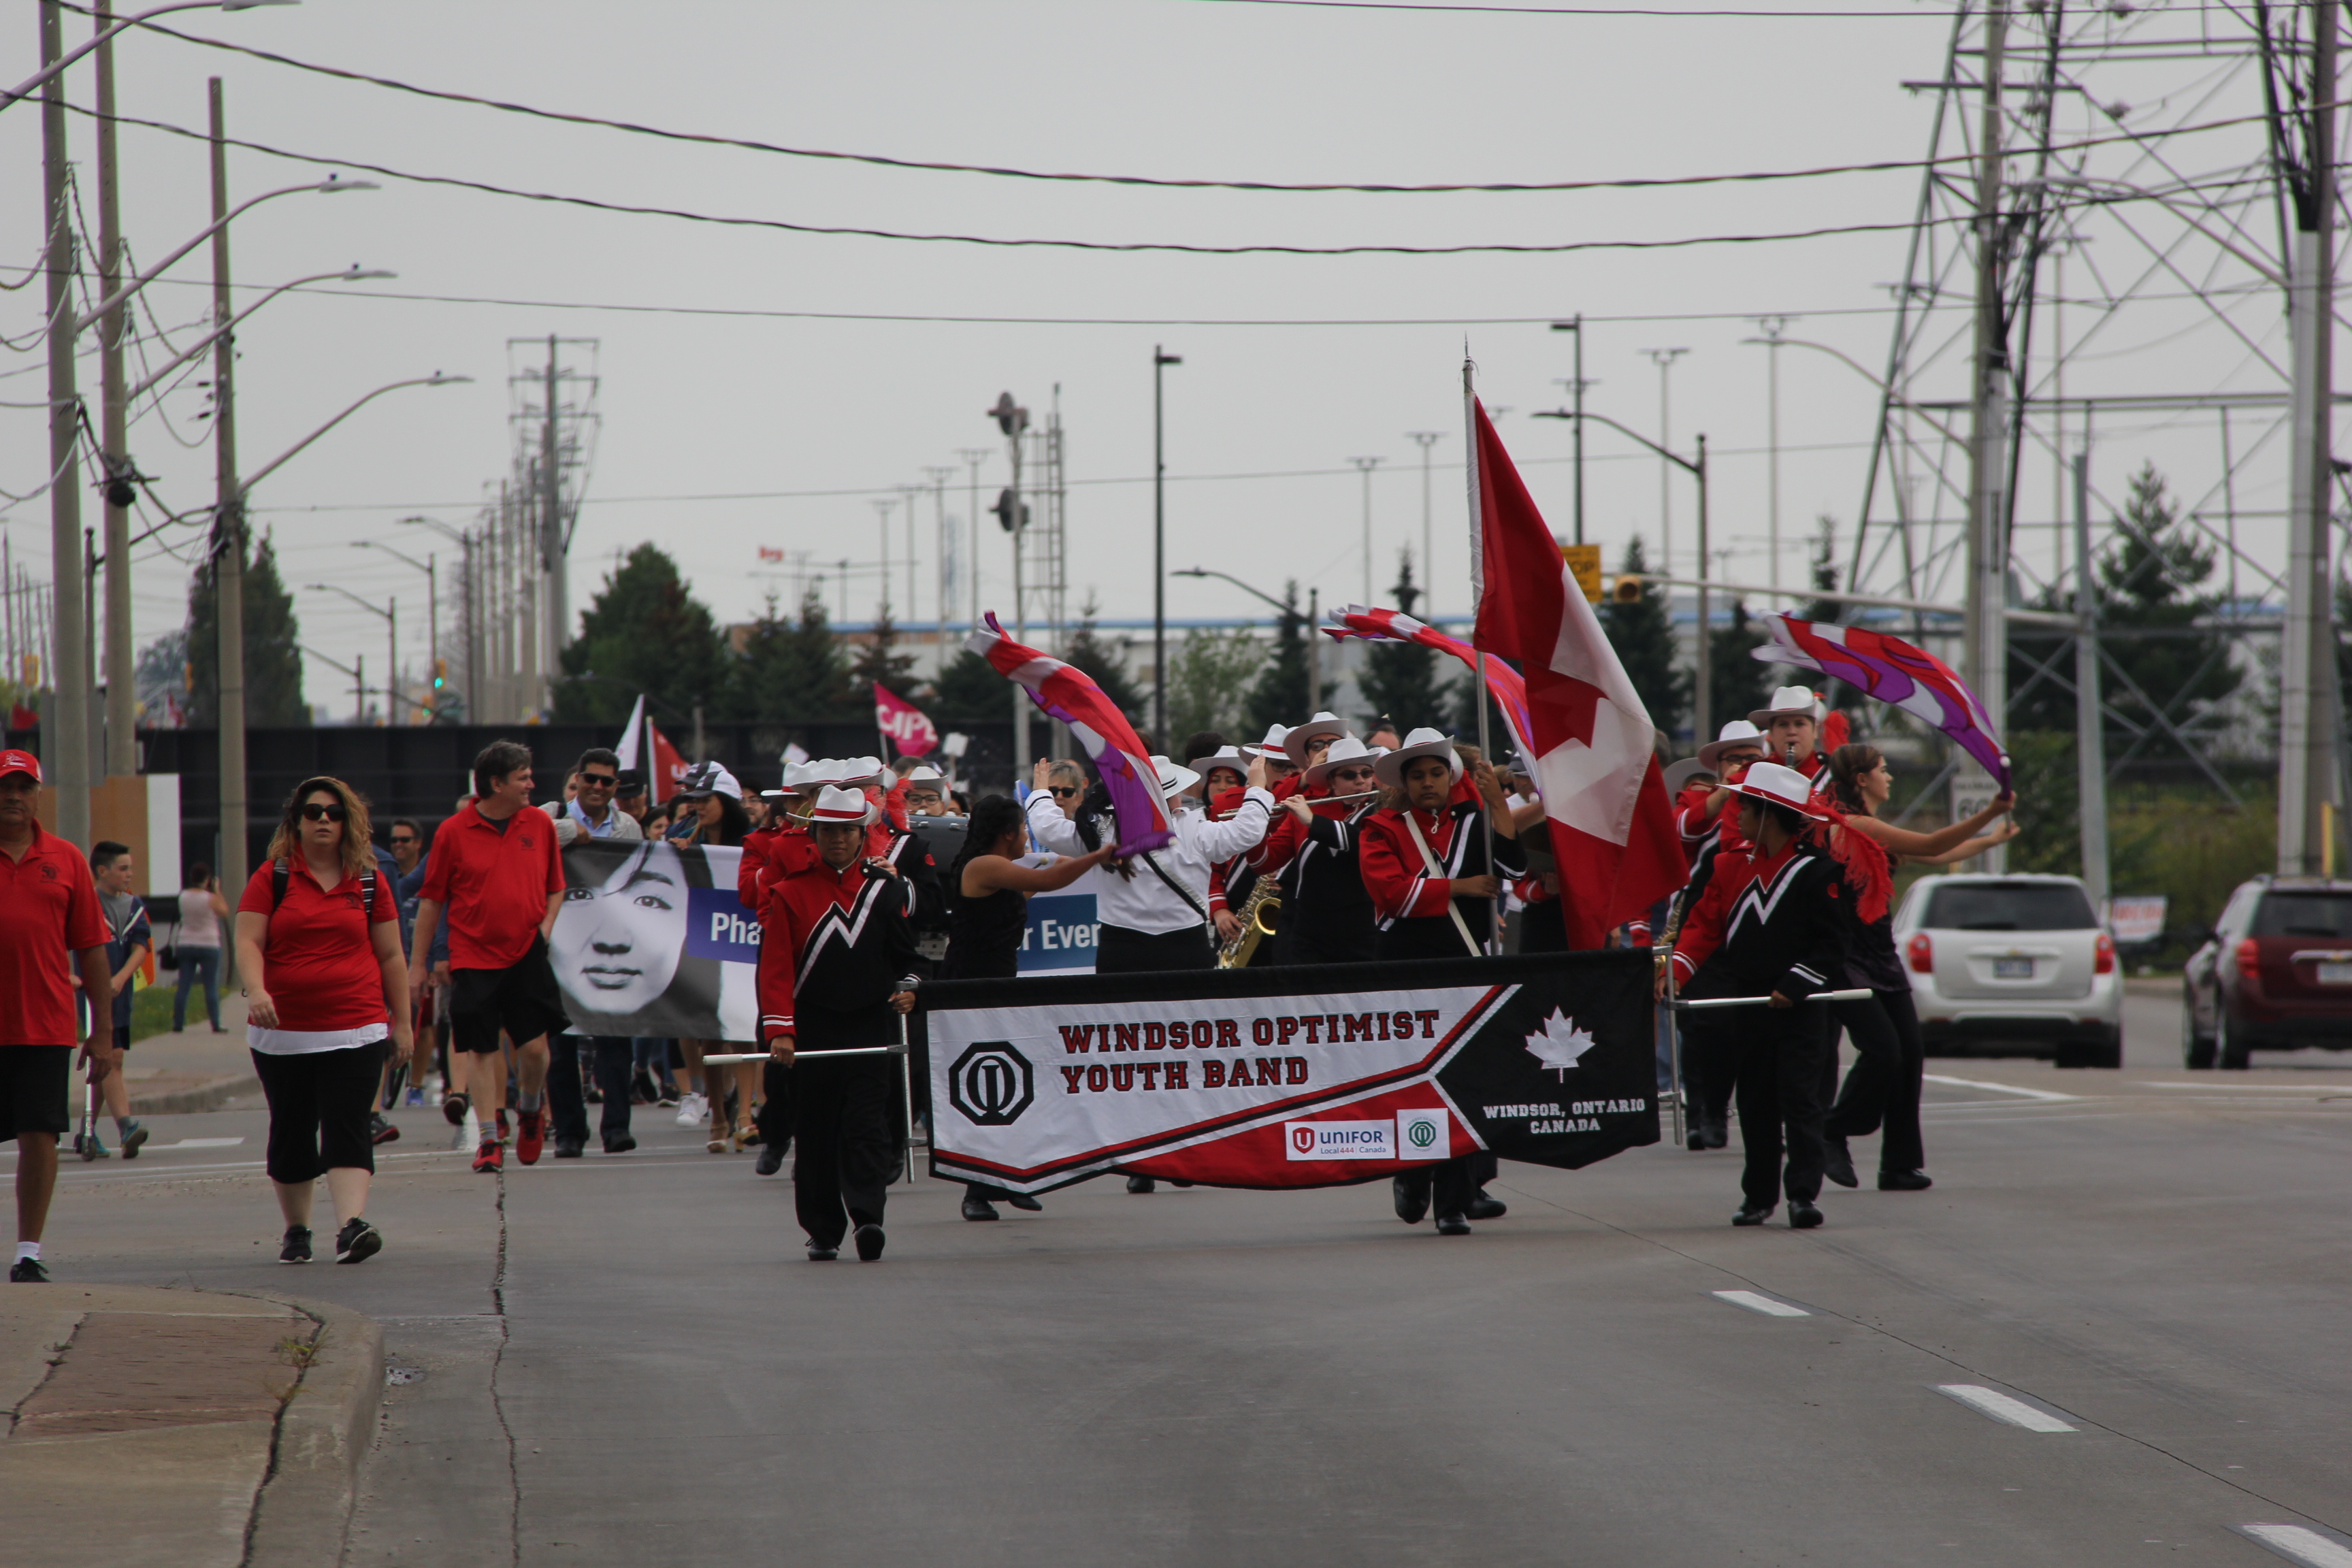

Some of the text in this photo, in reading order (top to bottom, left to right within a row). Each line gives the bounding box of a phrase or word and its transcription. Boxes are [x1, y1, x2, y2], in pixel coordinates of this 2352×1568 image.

[1041, 919, 1102, 949] Ever
[1058, 1009, 1439, 1054] WINDSOR OPTIMIST
[1061, 1056, 1309, 1094] YOUTH BAND
[1483, 1098, 1646, 1119] WINDSOR, ONTARIO
[1531, 1117, 1601, 1134] CANADA
